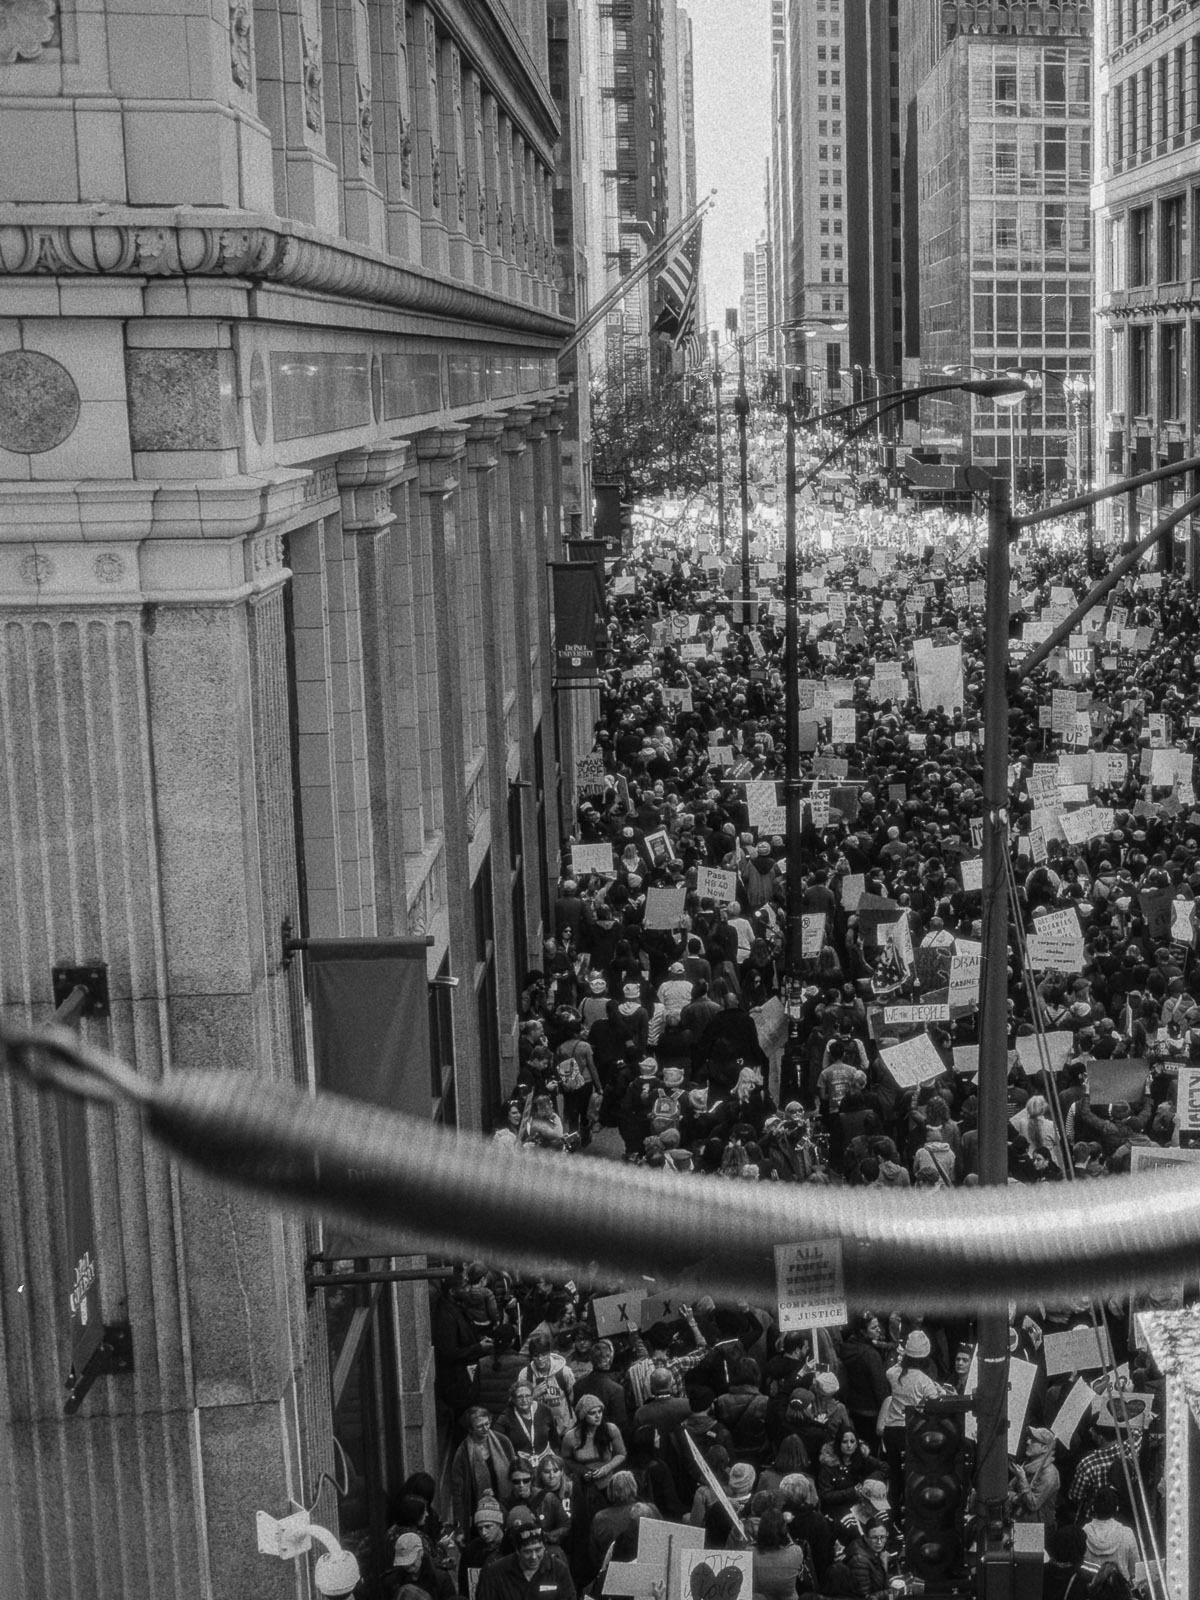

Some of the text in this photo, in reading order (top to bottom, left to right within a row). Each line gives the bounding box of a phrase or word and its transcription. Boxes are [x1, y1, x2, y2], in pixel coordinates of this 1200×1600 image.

[1069, 649, 1093, 661] NOT
[1073, 661, 1090, 674] OK
[1066, 732, 1082, 743] UP
[811, 790, 830, 800] HOP
[707, 870, 727, 880] Pass
[718, 882, 728, 890] 40
[953, 957, 980, 969] DRAI
[950, 978, 979, 988] CABINE
[884, 1008, 898, 1022] WE
[911, 1006, 947, 1020] PEOPLE
[796, 1247, 823, 1260] ALL
[617, 1299, 672, 1321] X X
[784, 1309, 843, 1322] & JUSTICE
